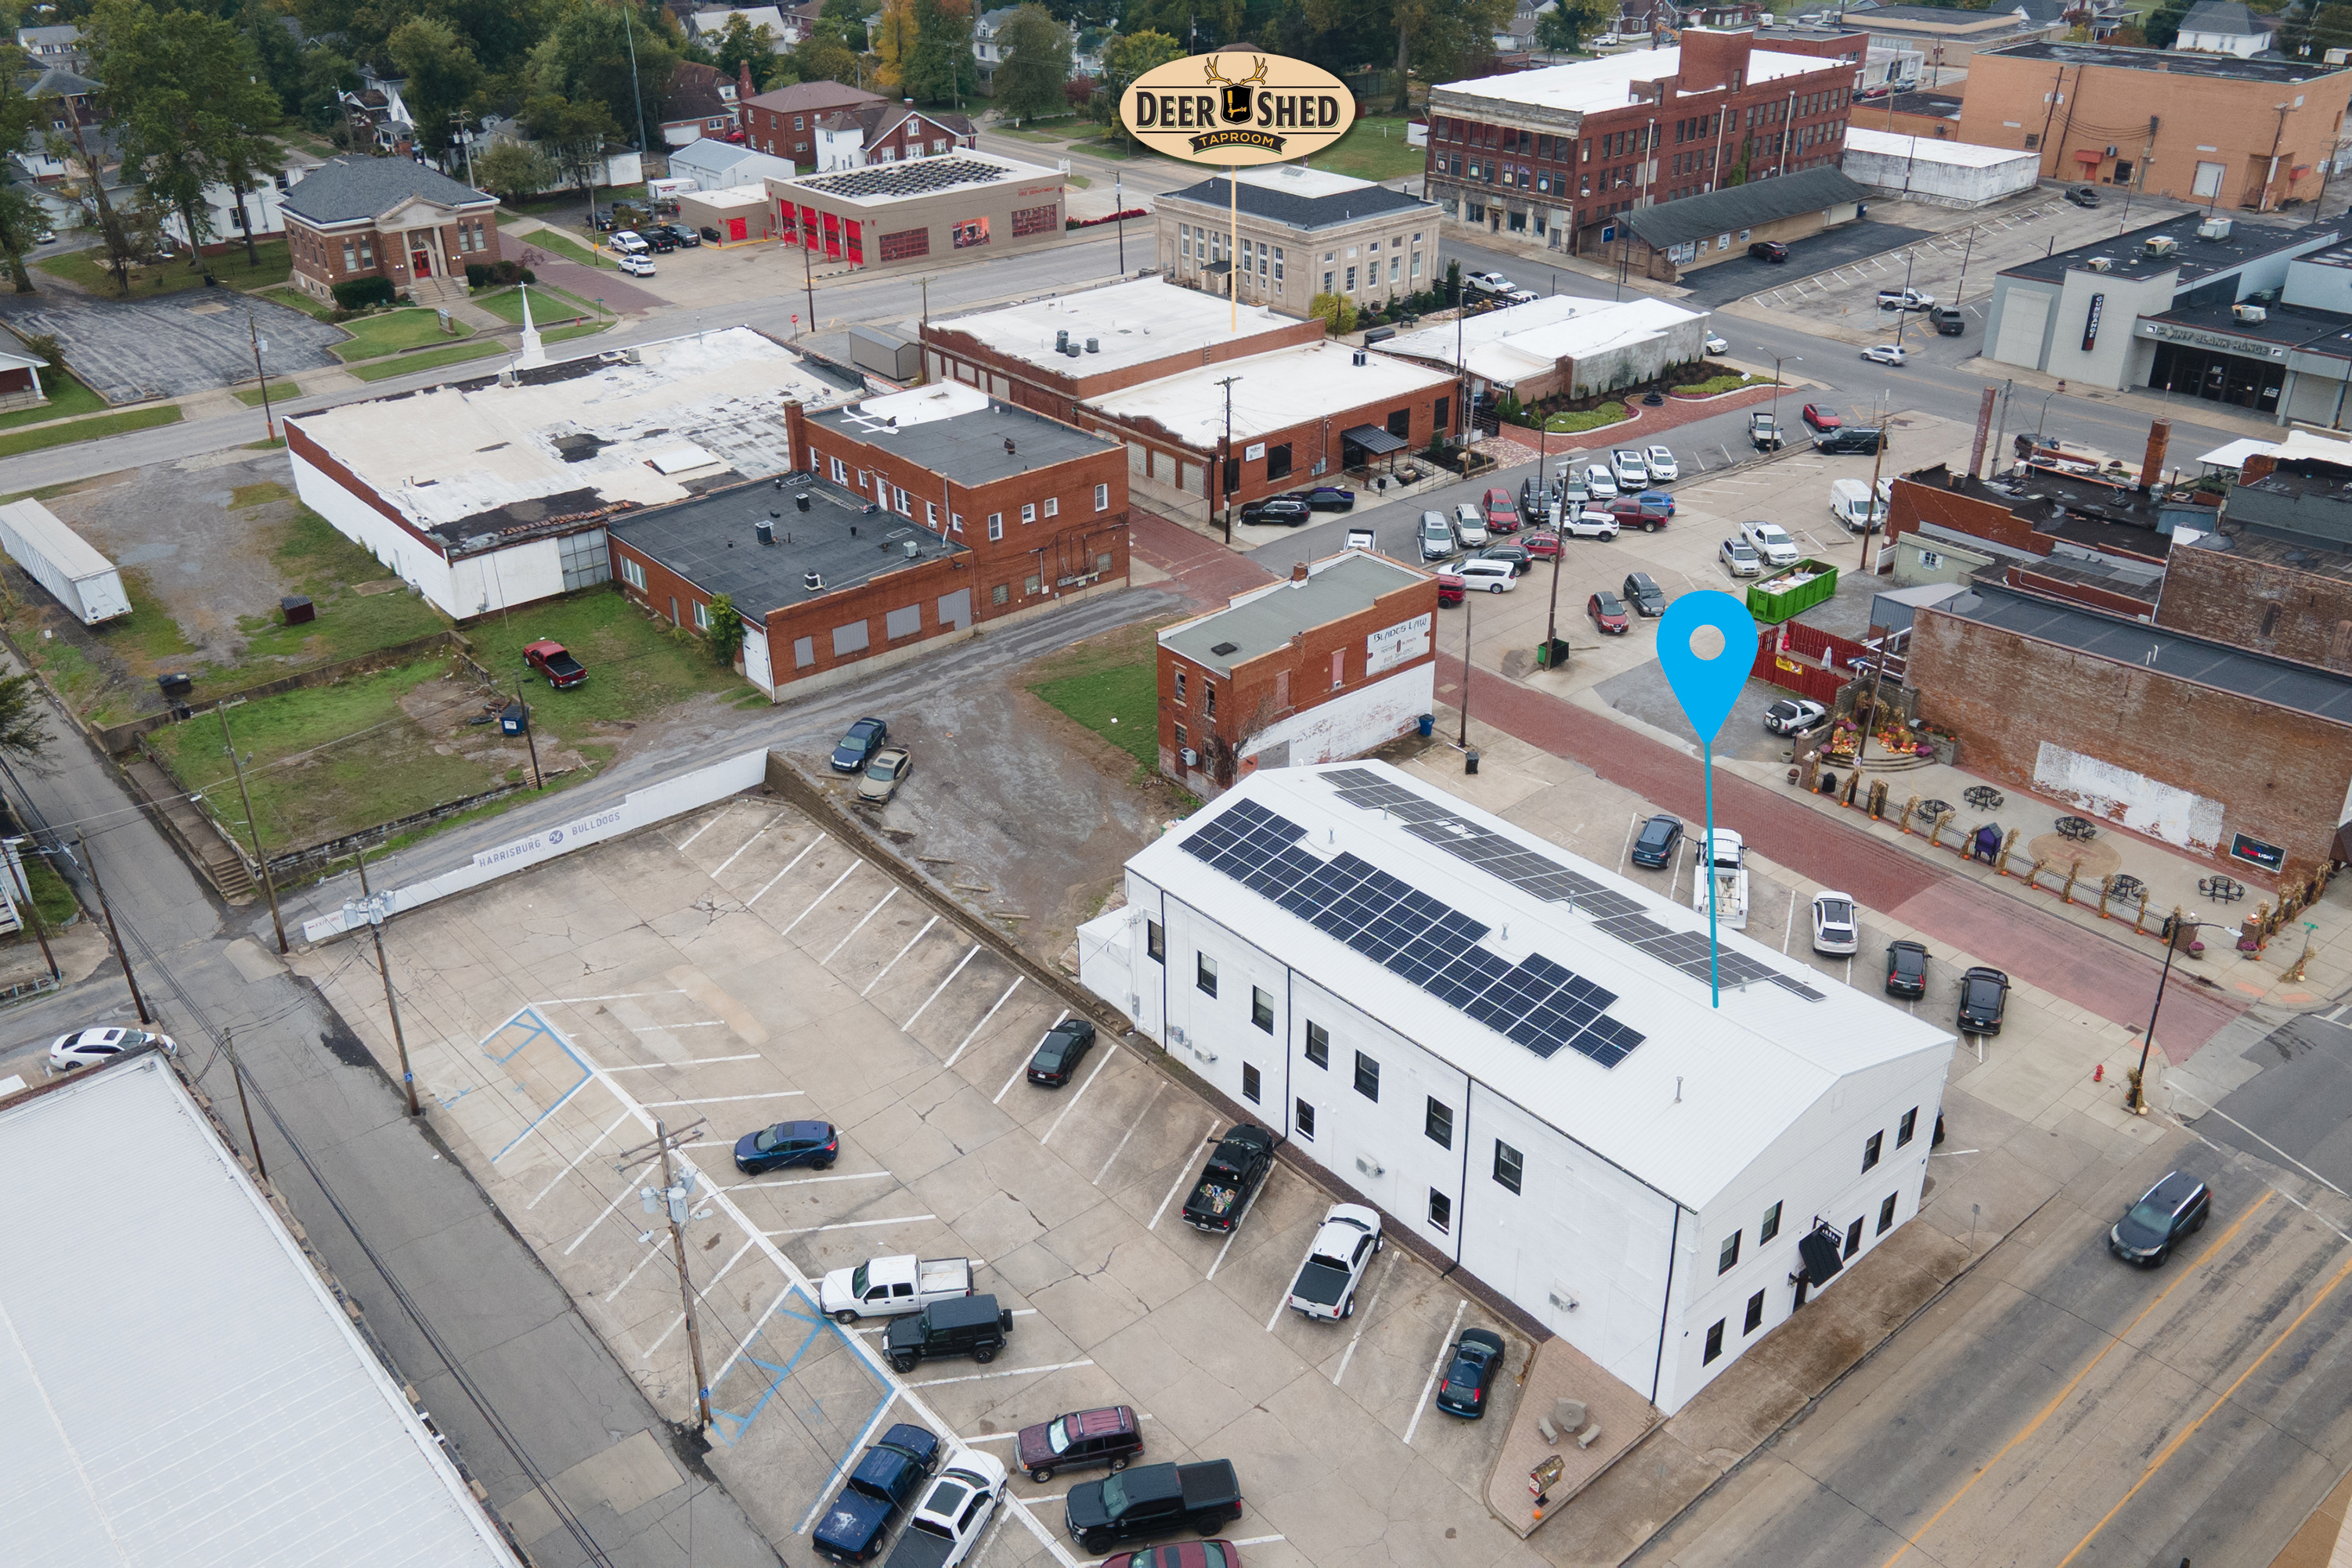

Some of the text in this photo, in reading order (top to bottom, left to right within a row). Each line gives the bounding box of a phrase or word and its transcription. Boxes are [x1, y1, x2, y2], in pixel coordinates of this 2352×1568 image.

[2158, 326, 2270, 355] POINT BLANK RANGE
[1409, 618, 1427, 631] LAW
[572, 812, 620, 835] BULLDOGS
[479, 839, 541, 867] HARRISBURG
[315, 914, 344, 928] EXIT ONLY
